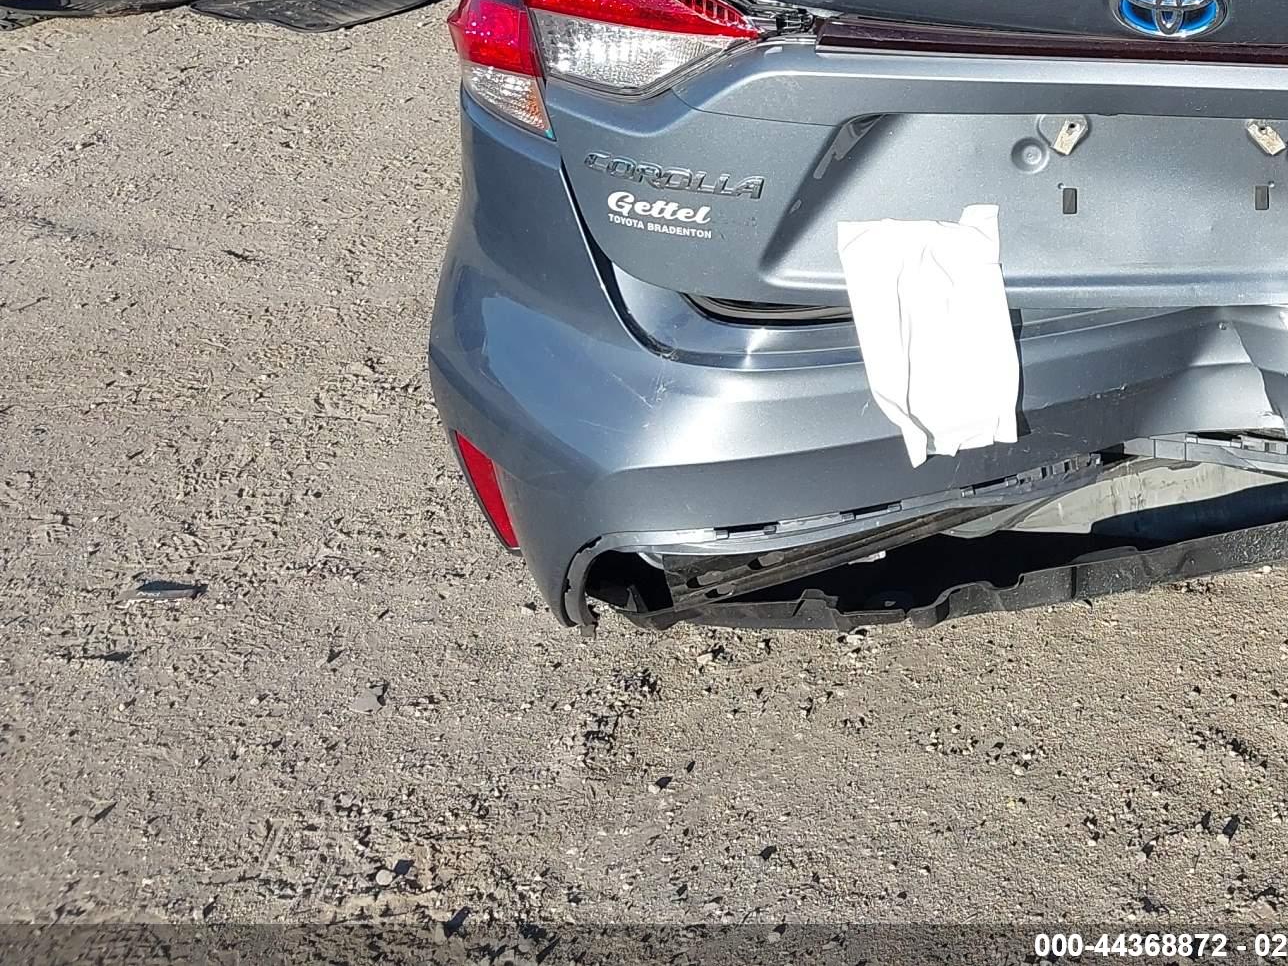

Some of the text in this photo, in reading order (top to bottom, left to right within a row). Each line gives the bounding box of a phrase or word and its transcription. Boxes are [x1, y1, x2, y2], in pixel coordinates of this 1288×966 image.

[584, 151, 766, 198] COROLLA
[607, 191, 711, 223] Gettel
[608, 214, 712, 238] TOYOTA BRADENTON
